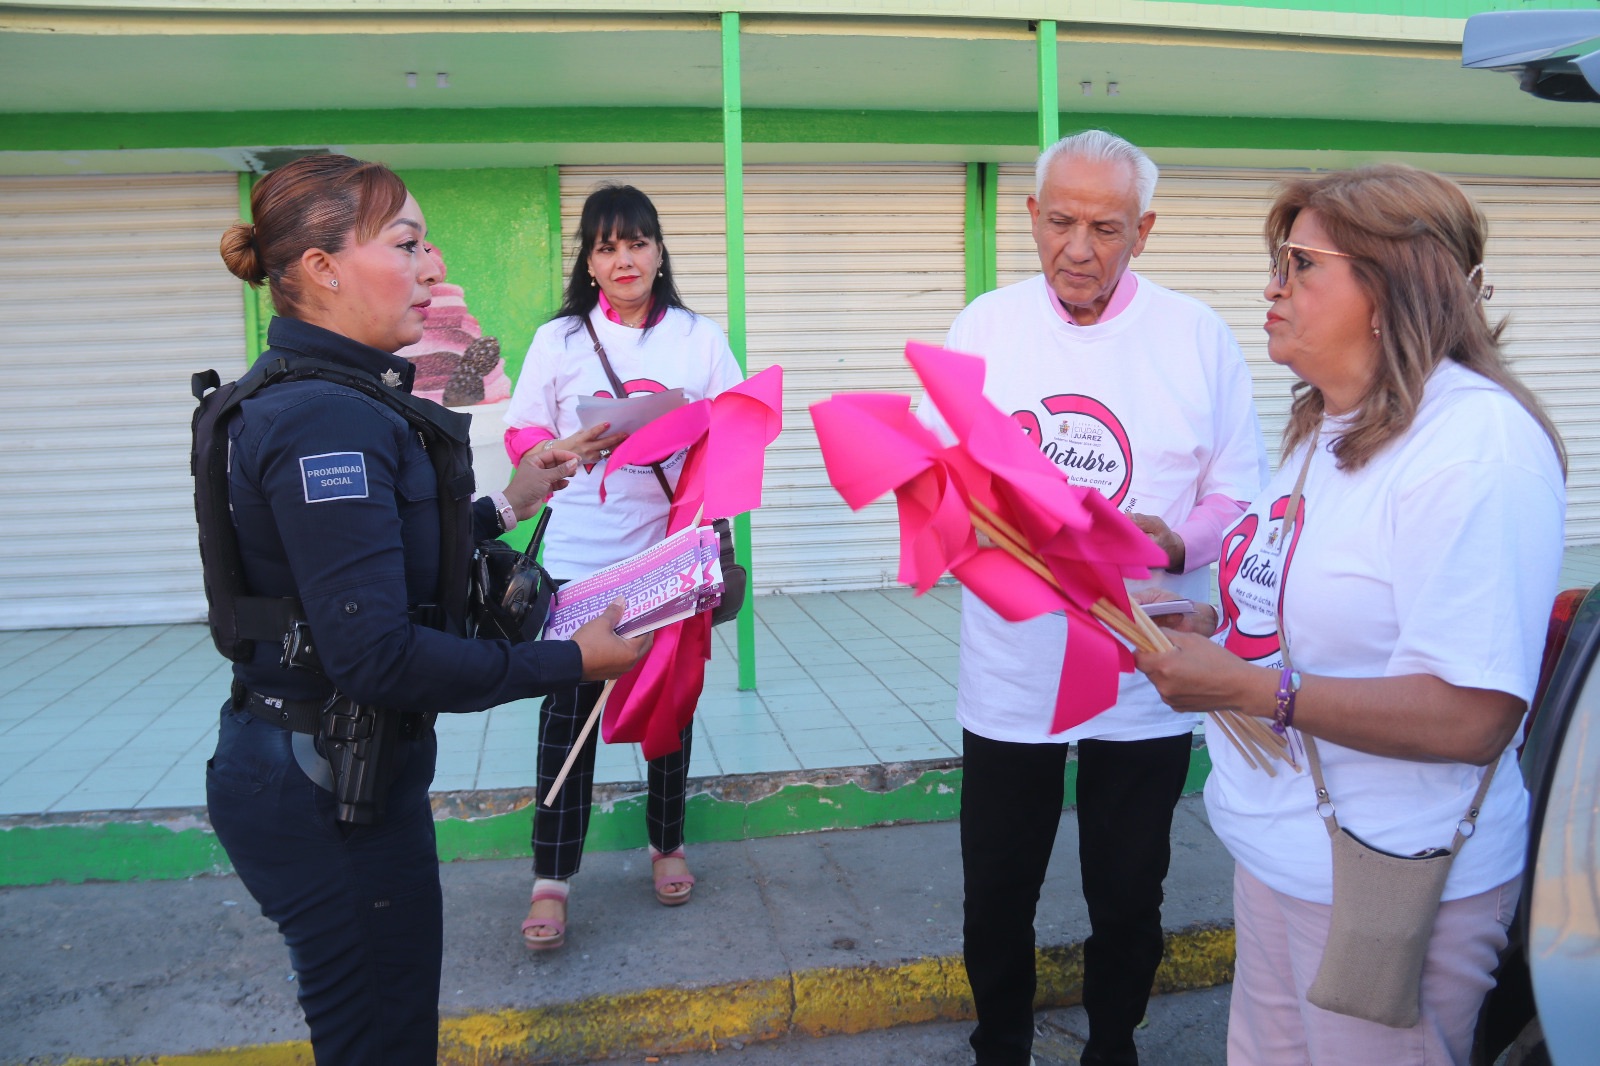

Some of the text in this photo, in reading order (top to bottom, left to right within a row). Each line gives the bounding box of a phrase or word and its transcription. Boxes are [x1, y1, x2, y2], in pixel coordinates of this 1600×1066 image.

[1074, 427, 1103, 435] CIUDAD
[1074, 433, 1102, 441] JUÁREZ
[1042, 441, 1119, 472] Octubre
[307, 466, 362, 478] PROXIMIDAD
[321, 477, 353, 487] SOCIAL
[1070, 475, 1088, 483] lucha
[1089, 478, 1112, 486] contra
[1241, 554, 1277, 588] Octu
[554, 611, 600, 637] MAMA
